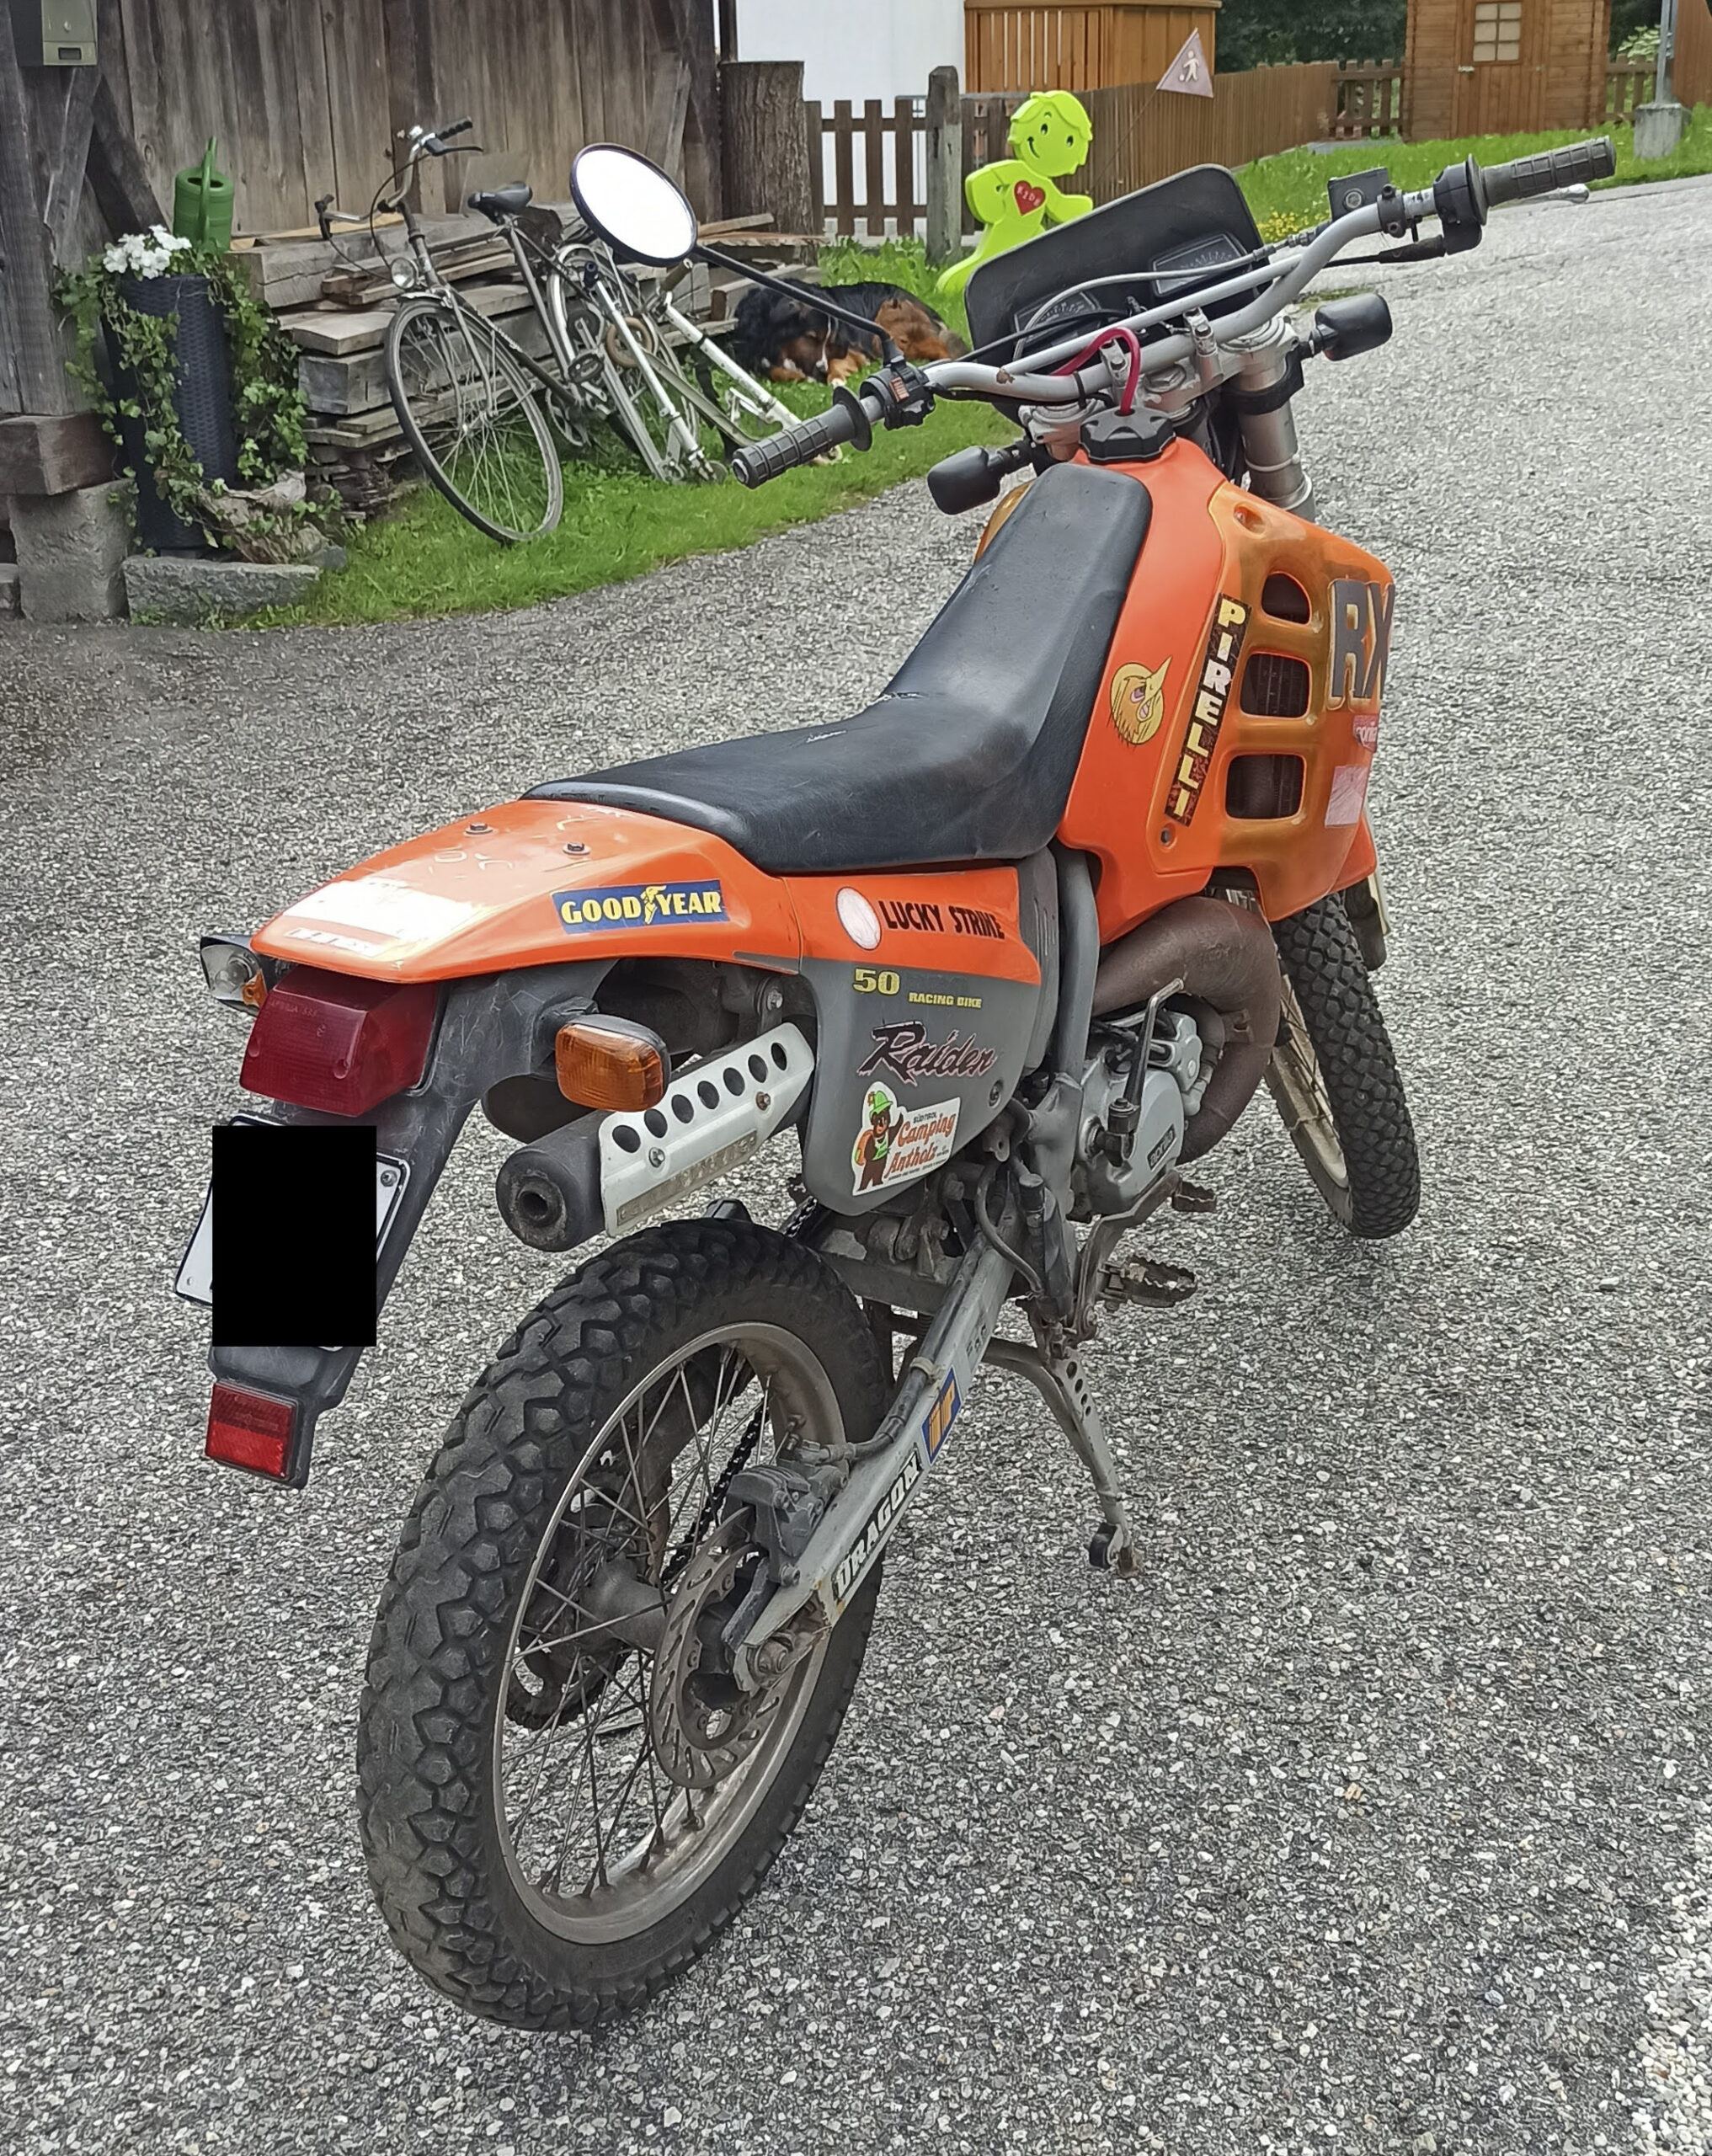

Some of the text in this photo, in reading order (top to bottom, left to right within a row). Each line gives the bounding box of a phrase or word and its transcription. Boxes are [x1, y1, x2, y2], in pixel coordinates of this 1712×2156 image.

[1172, 597, 1246, 817] PIRELLI
[878, 900, 1005, 940] LUCKY STRIKE
[852, 968, 901, 995] 50
[908, 992, 983, 1009] RACING BIKE
[898, 1113, 957, 1148] Camping
[883, 1141, 938, 1179] Antholz
[835, 1447, 922, 1598] DRAGON
